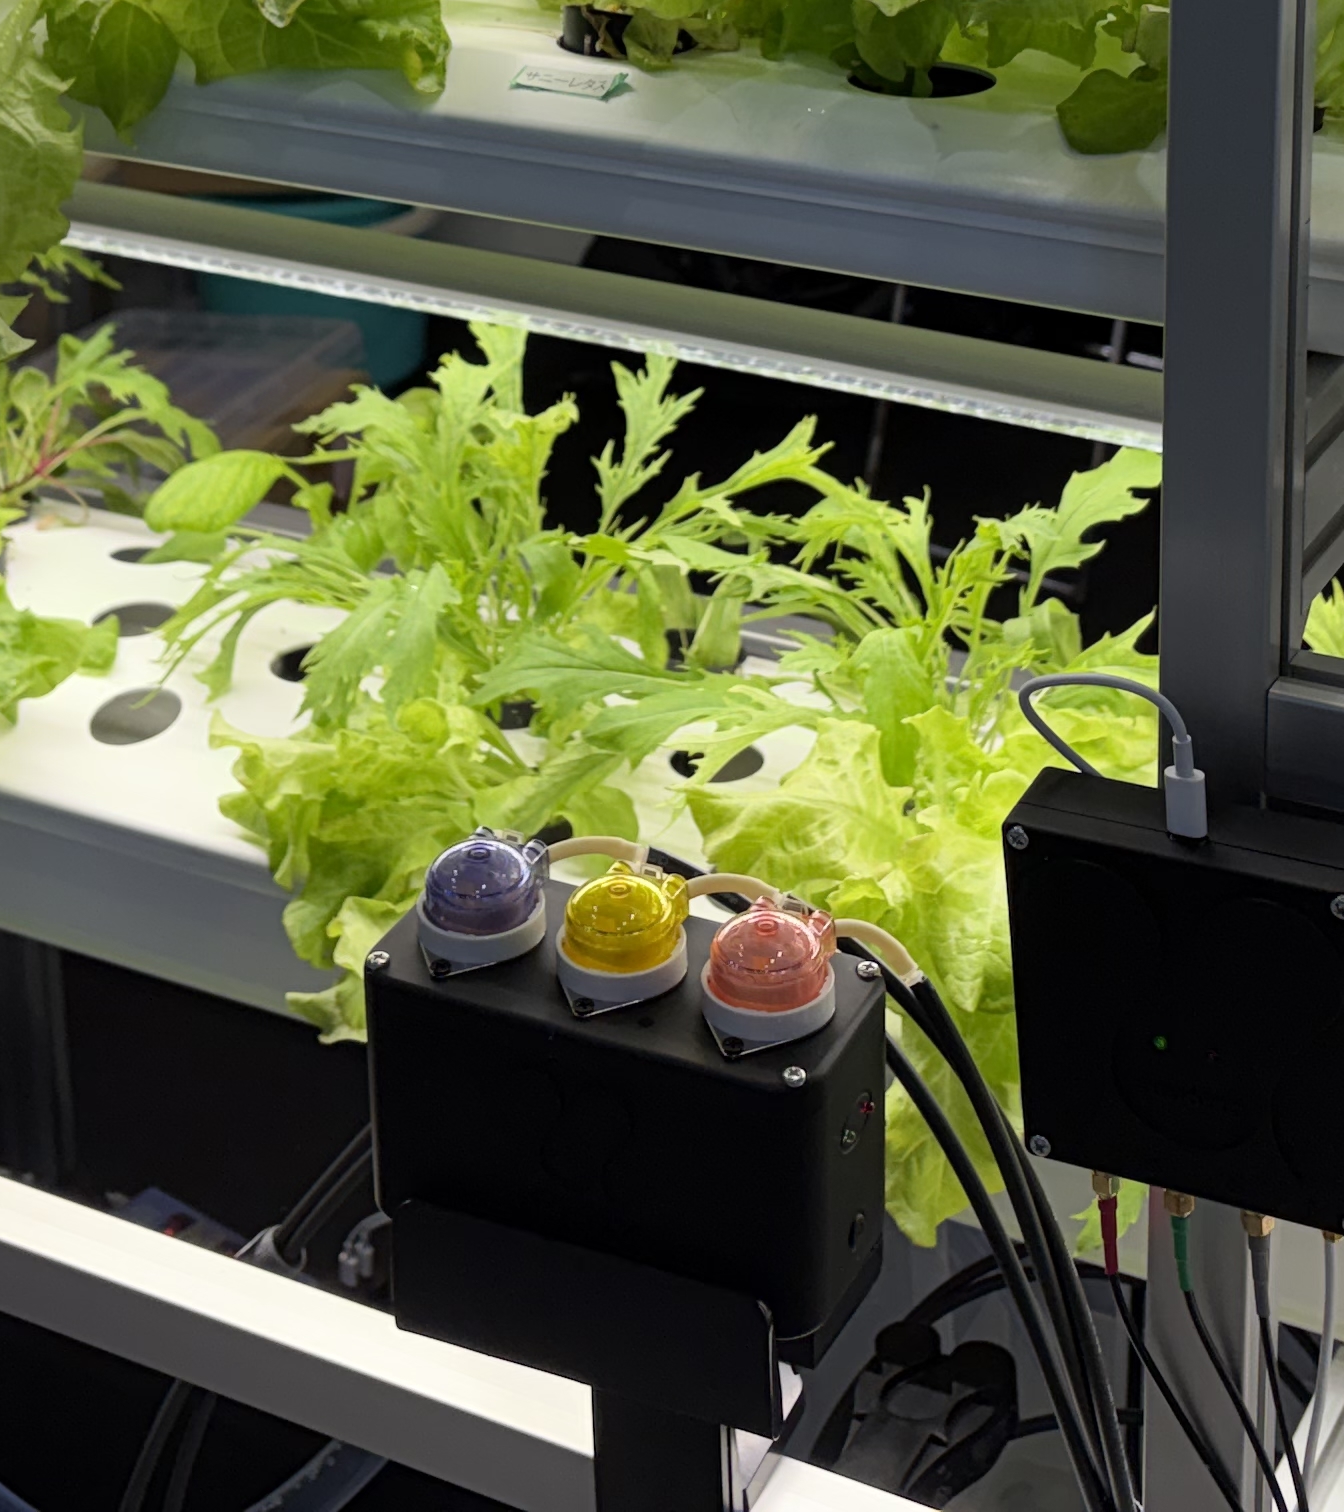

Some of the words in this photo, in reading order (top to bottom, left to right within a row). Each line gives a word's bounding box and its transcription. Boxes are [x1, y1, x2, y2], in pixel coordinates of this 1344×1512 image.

[526, 71, 607, 91] サニーレタス
